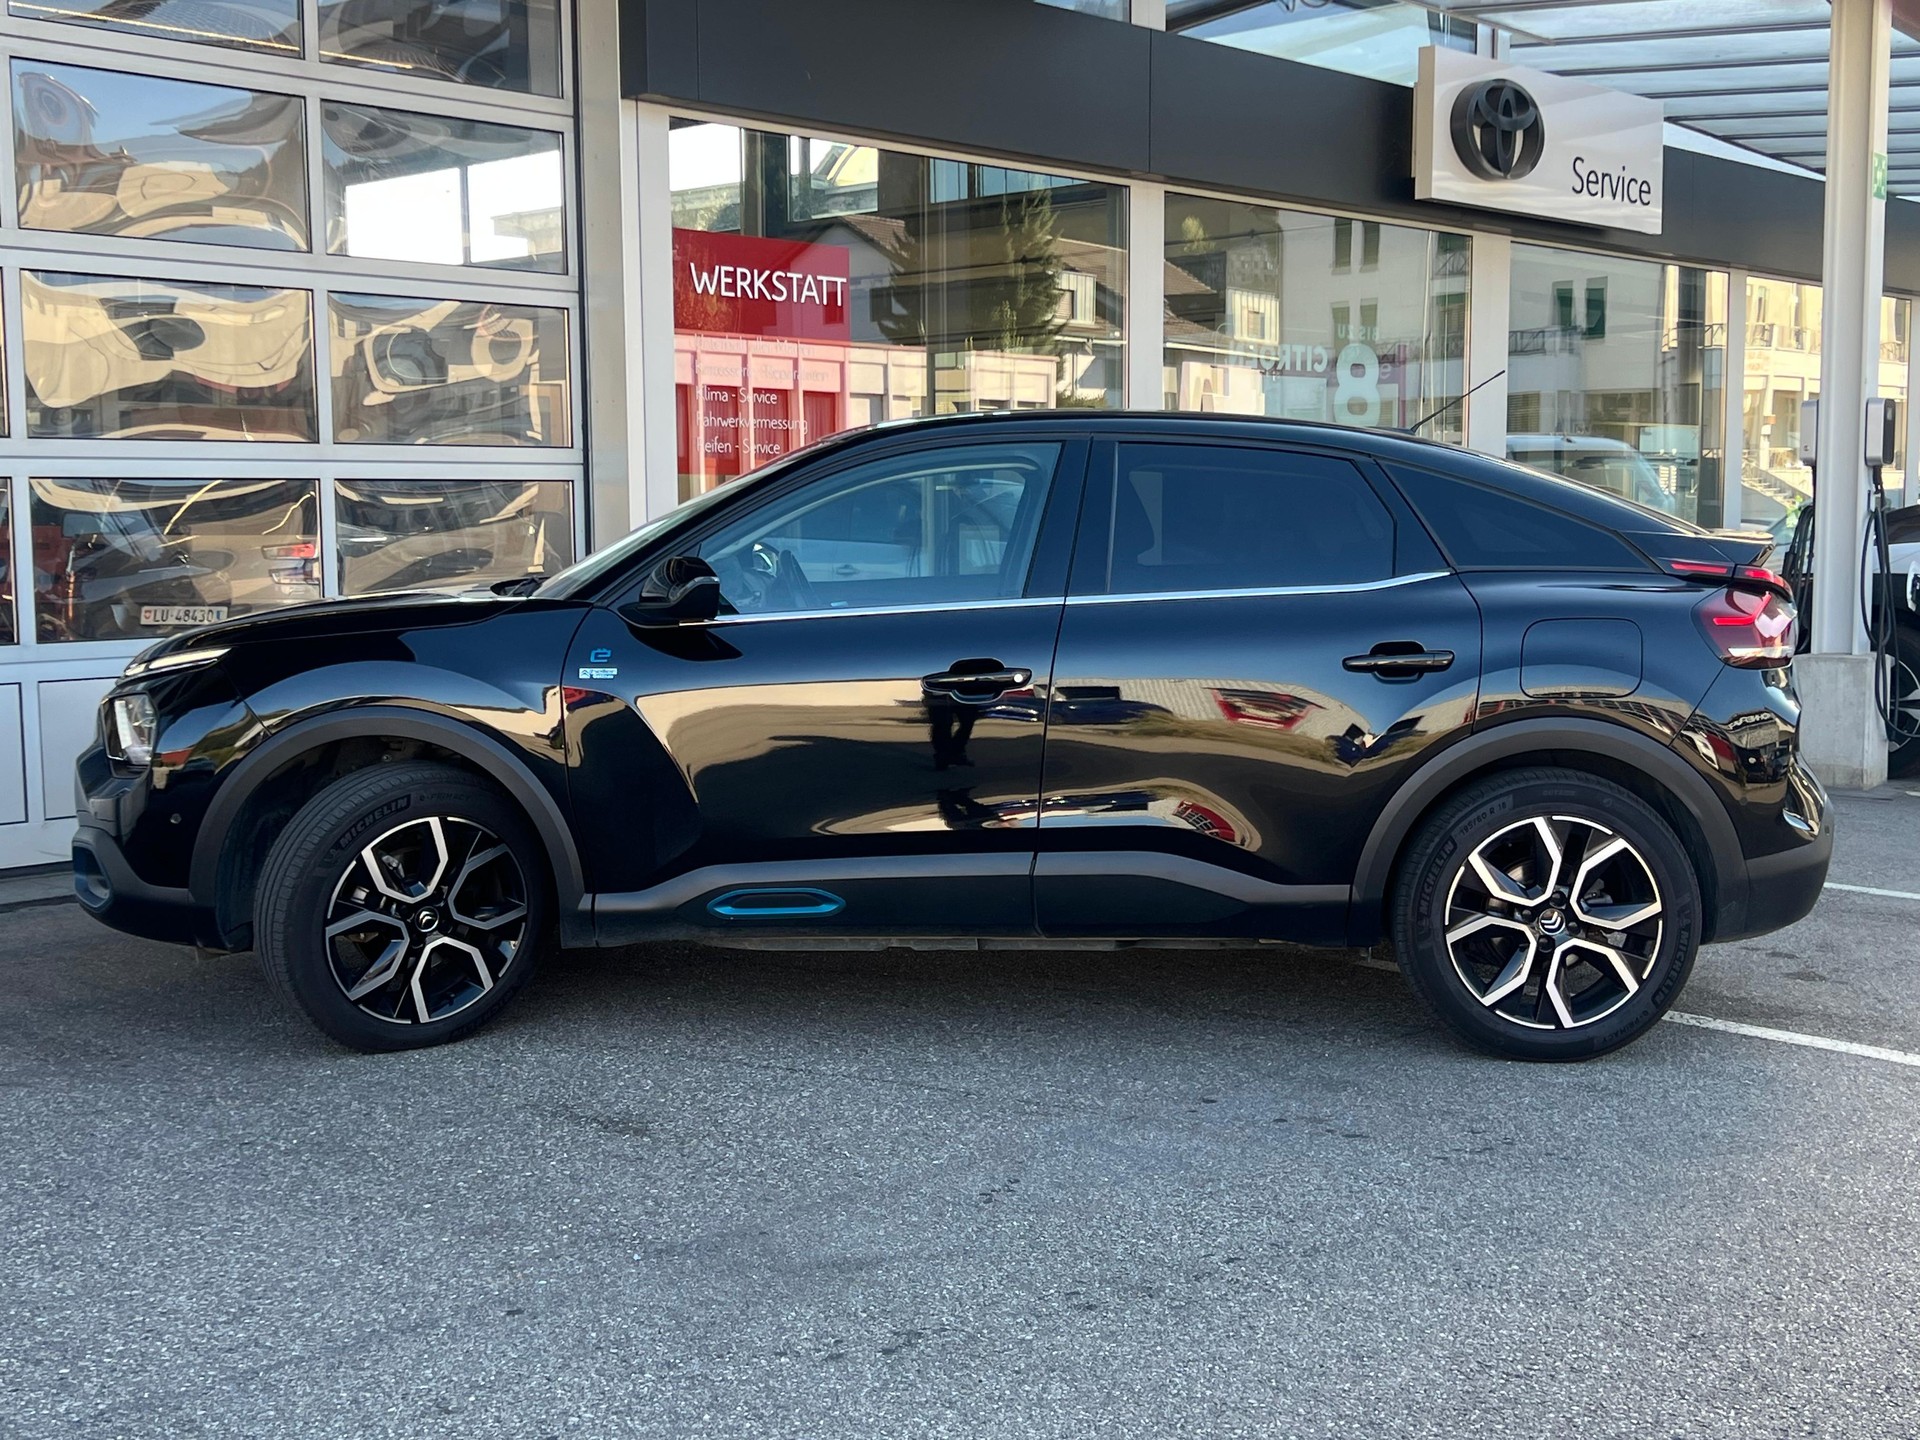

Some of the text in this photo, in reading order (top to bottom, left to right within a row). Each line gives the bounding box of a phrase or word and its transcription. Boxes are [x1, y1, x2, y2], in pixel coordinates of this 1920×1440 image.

[1572, 156, 1651, 206] Service
[690, 262, 847, 307] WERKSTATT
[739, 387, 778, 405] Service
[742, 438, 781, 455] Service
[339, 796, 408, 848] MICHELIN
[1419, 839, 1456, 916] MICHELIN
